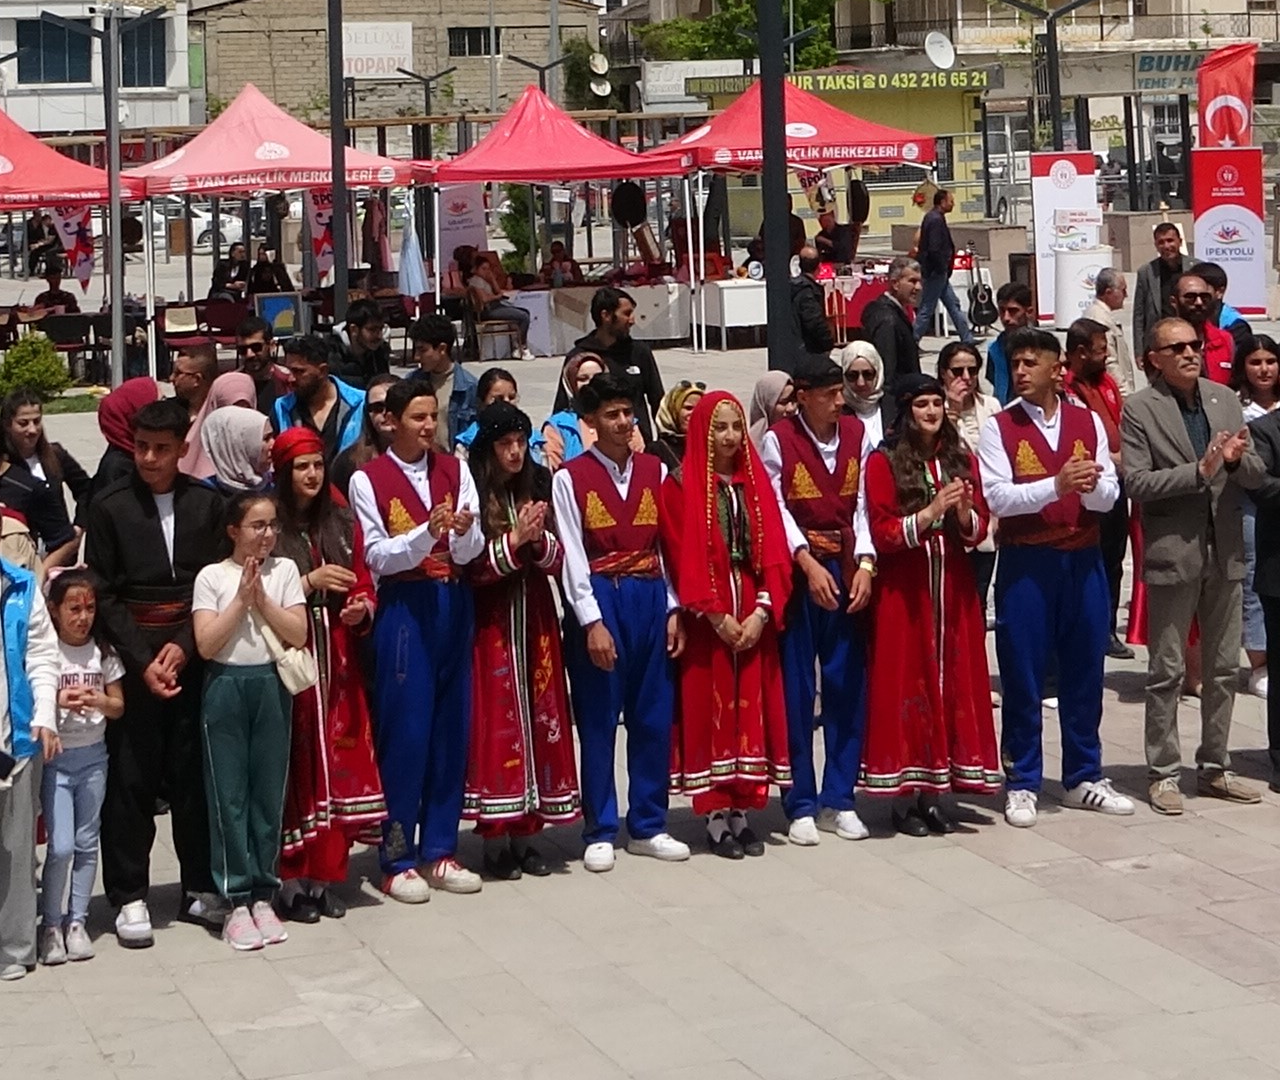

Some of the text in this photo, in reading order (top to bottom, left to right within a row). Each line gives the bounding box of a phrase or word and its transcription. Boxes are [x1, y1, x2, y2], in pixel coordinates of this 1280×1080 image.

[344, 56, 407, 74] TOPARK
[878, 74, 887, 88] 0
[891, 73, 918, 88] 432
[921, 73, 947, 88] 216
[950, 72, 968, 86] 65
[971, 71, 988, 86] 21
[738, 143, 898, 161] VAN NÇLİK MERKEZLERİ
[195, 167, 373, 189] VAN GENÇLİK MERKLERİ
[312, 193, 333, 206] SPO
